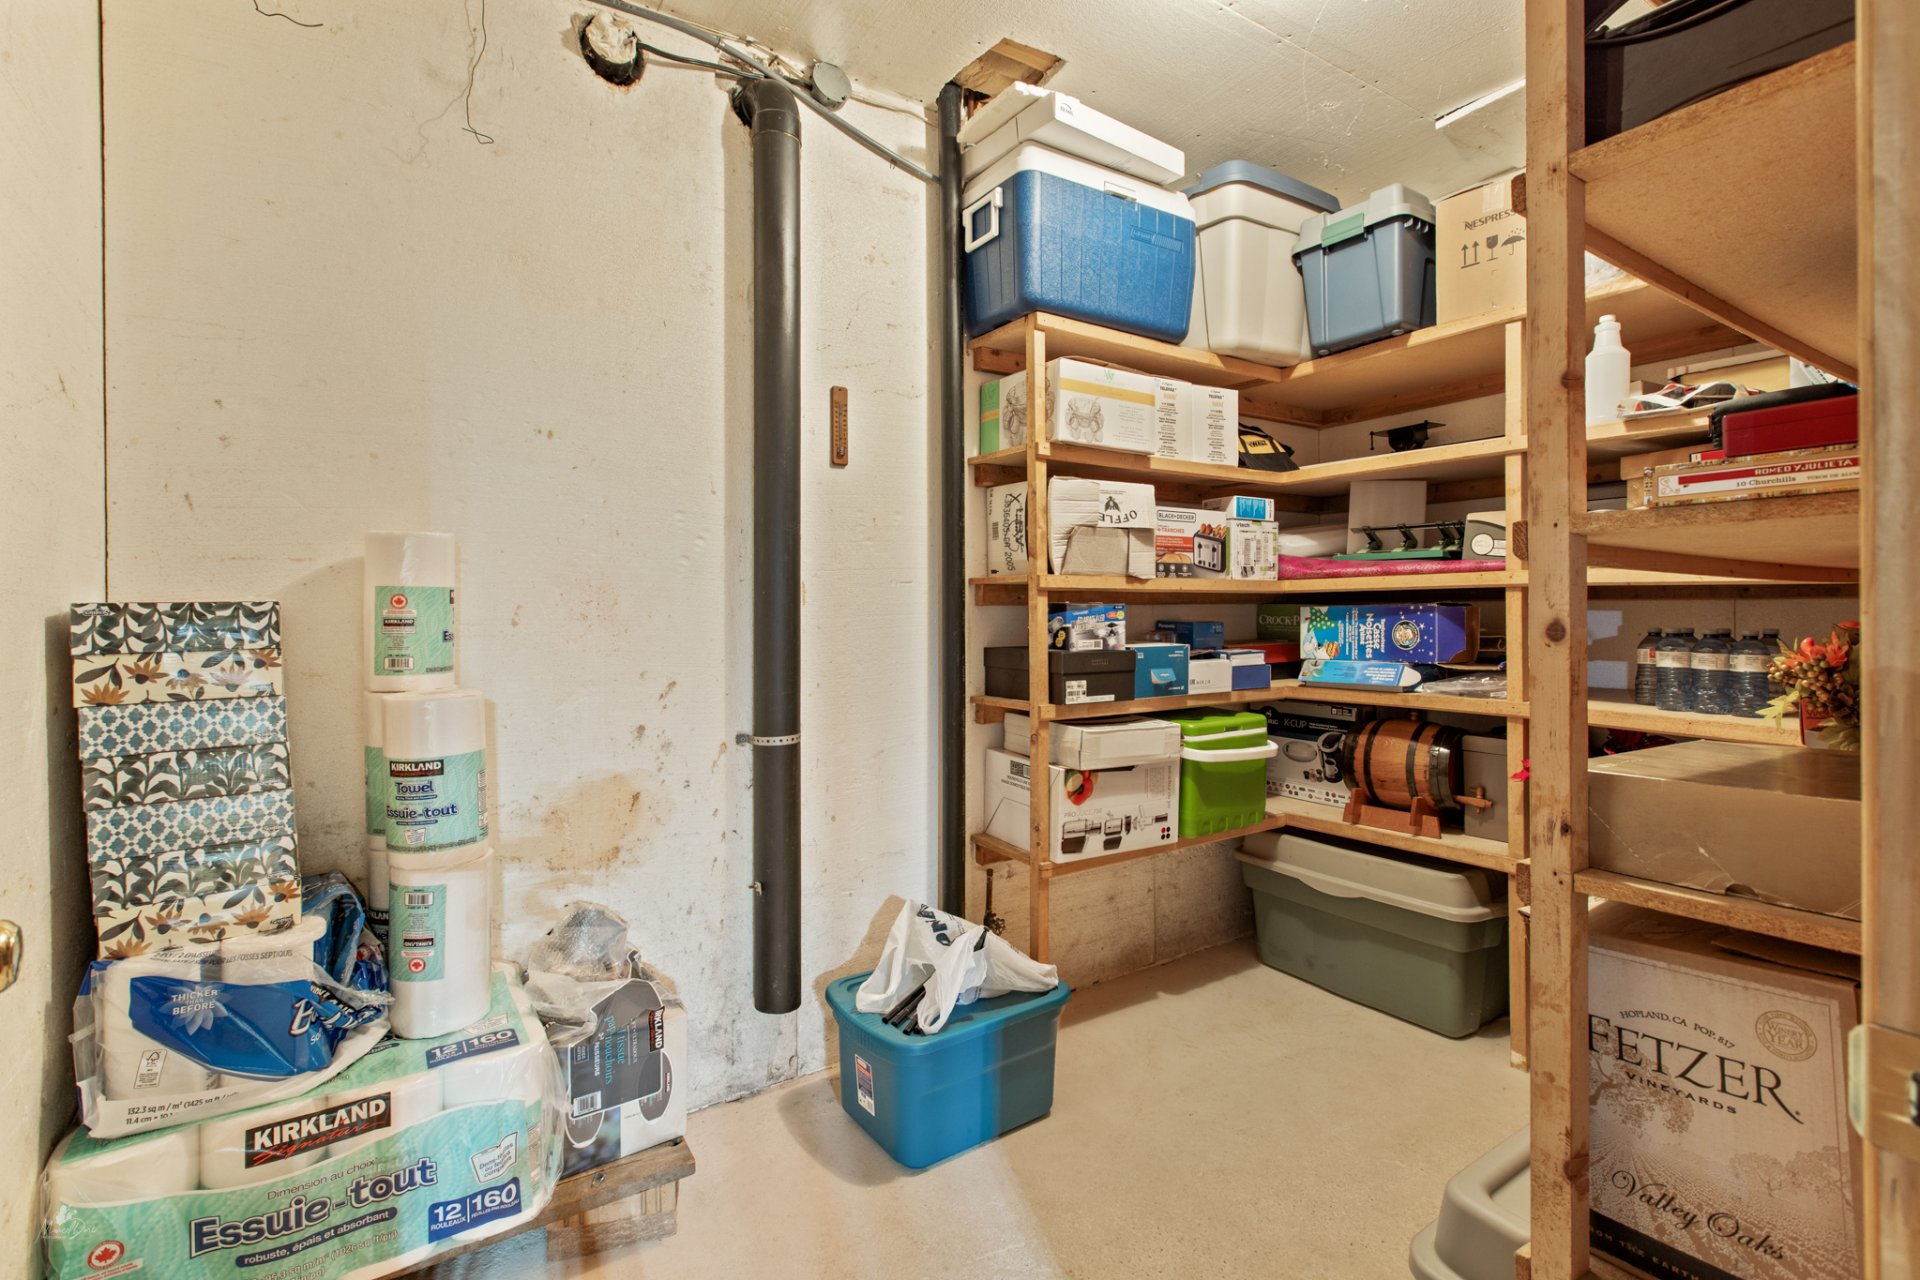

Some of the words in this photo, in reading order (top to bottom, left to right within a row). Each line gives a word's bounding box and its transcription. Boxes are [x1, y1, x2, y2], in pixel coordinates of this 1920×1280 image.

[1463, 208, 1516, 231] NESPRESS
[1754, 466, 1791, 476] ROMEO
[1801, 459, 1853, 471] JULIETA
[1749, 475, 1796, 486] Churchills
[1098, 510, 1138, 524] OFFLE
[1365, 613, 1374, 659] Noisettes
[1283, 718, 1307, 729] K-CUP
[391, 761, 442, 771] KIRKLAND
[395, 780, 435, 794] Towel
[171, 989, 218, 1002] THICKER
[172, 1002, 216, 1016] BEFORE
[468, 1030, 513, 1046] 160
[1588, 1013, 1804, 1125] FETZER
[1625, 1071, 1737, 1114] VINEYARDS
[127, 1105, 147, 1115] 132.3
[126, 1116, 139, 1125] 11.4
[253, 1098, 386, 1151] KIRKLAND
[252, 1119, 386, 1167] Signature
[267, 1177, 327, 1200] Dimension
[330, 1171, 344, 1181] au
[346, 1158, 375, 1175] choix
[189, 1156, 438, 1260] Essuie-tout
[433, 1202, 462, 1222] 12
[471, 1183, 517, 1212] 160
[501, 1199, 520, 1209] ROULEAU
[430, 1216, 467, 1231] ROULEAUX
[1611, 1170, 1700, 1230] Valley
[1707, 1212, 1786, 1261] Oaks
[244, 1248, 290, 1266] robuste,
[292, 1234, 322, 1253] épais
[323, 1229, 335, 1239] et
[337, 1210, 389, 1234] absorbant
